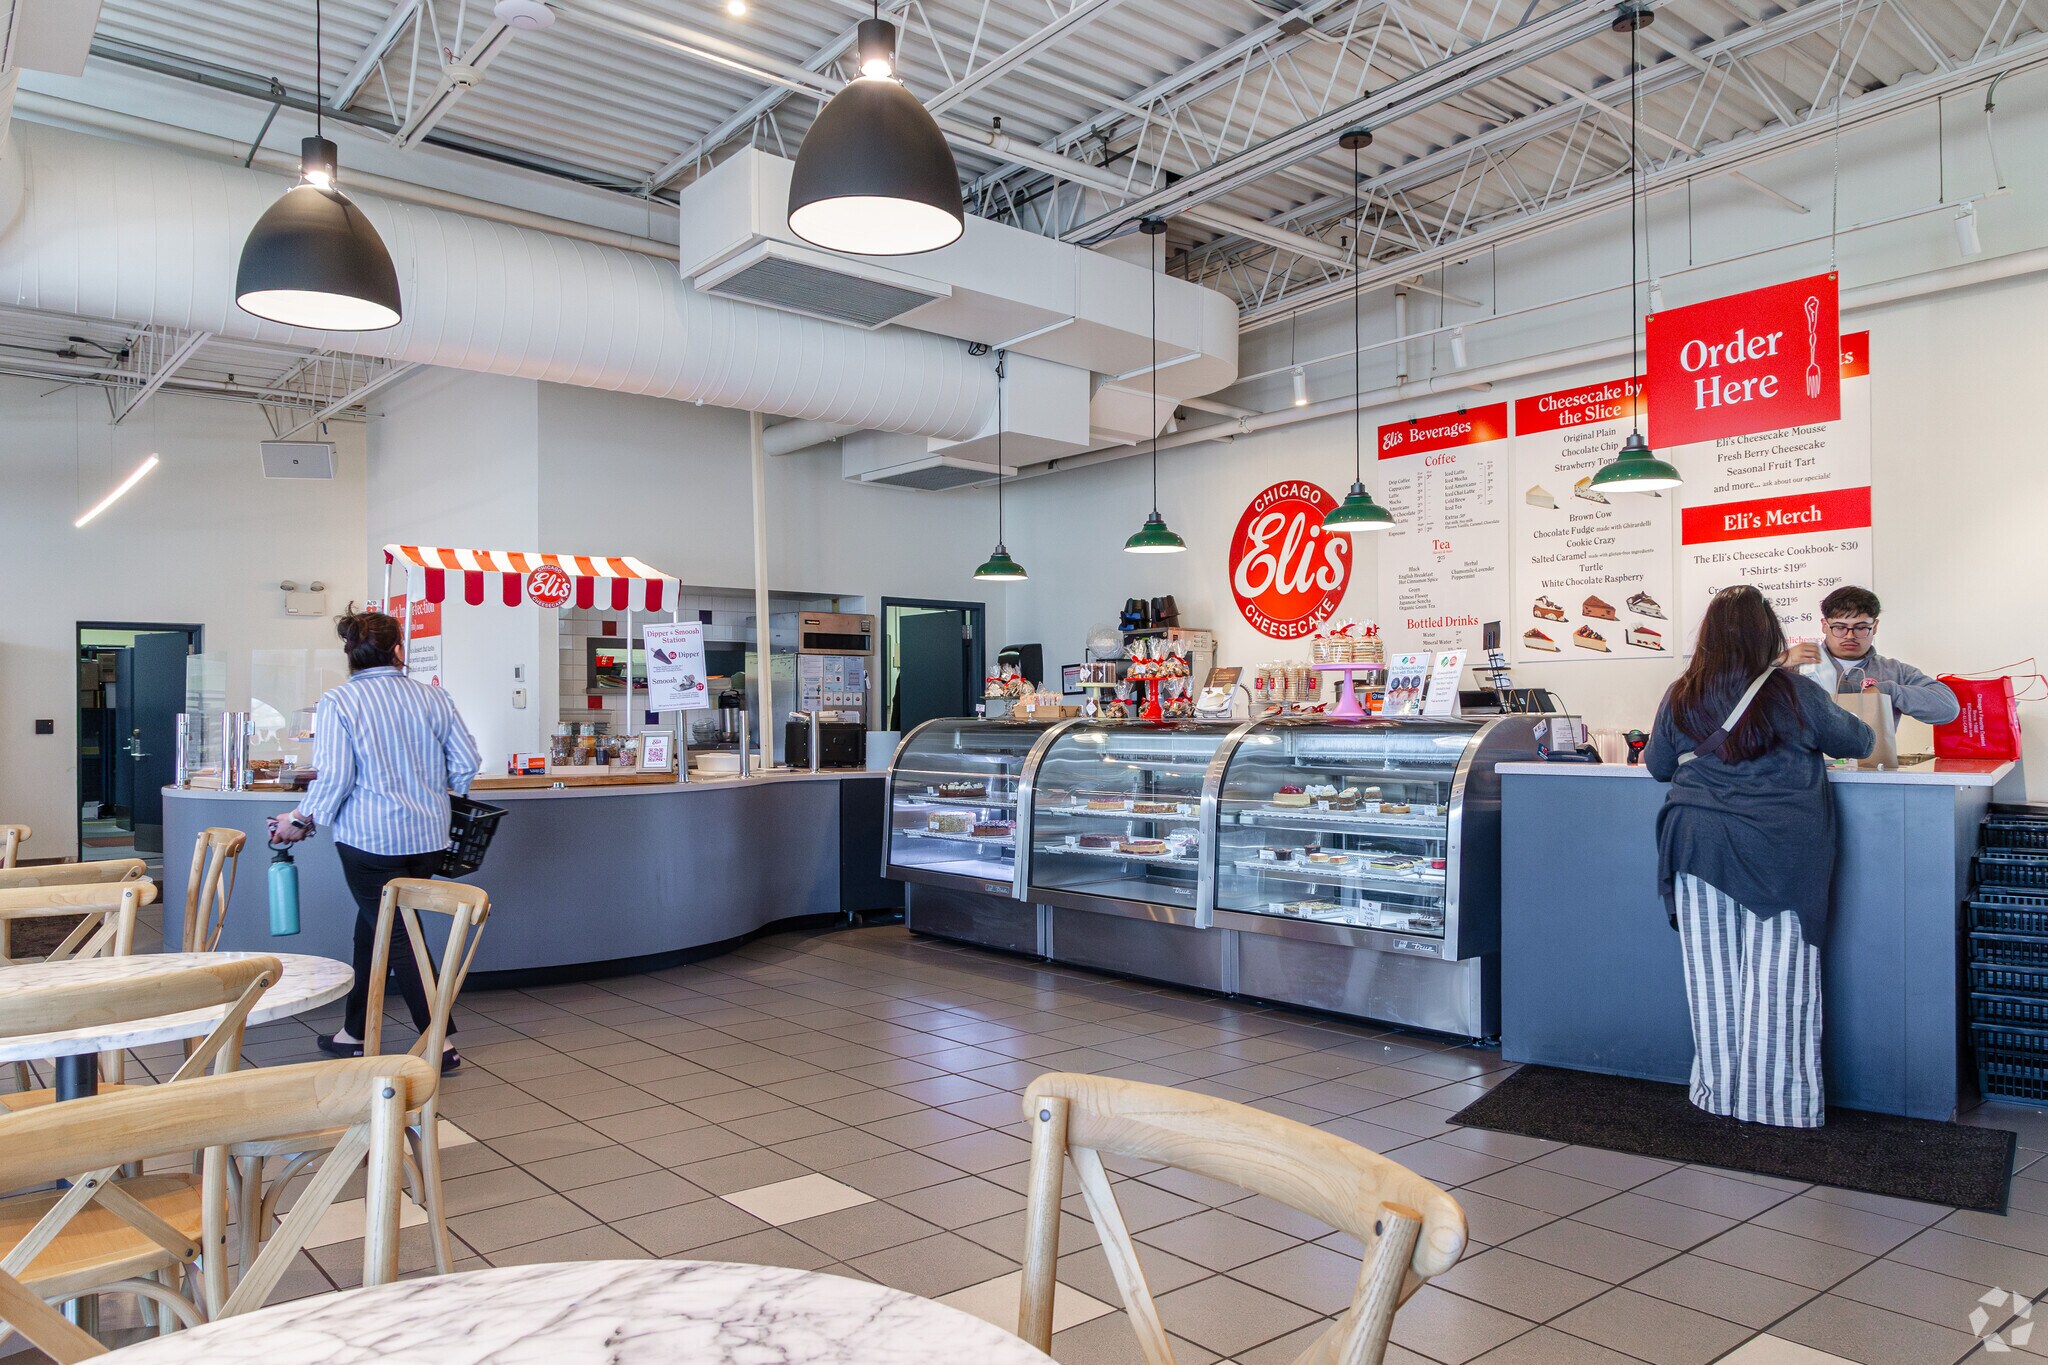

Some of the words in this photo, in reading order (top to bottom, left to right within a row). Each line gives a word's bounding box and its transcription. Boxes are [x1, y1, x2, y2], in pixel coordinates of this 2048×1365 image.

[1680, 328, 1783, 372] Order
[1538, 385, 1622, 412] Cheesecake
[1624, 381, 1642, 398] by
[1694, 374, 1778, 410] Here
[1558, 410, 1582, 426] the
[1585, 404, 1622, 422] Slice
[1409, 422, 1472, 442] Beverages
[1563, 430, 1595, 444] Original
[1596, 428, 1616, 438] Plain
[1716, 437, 1735, 448] Eli's
[1738, 430, 1789, 444] Cheesecake
[1792, 426, 1826, 436] Mousse
[1562, 445, 1599, 458] Chocolate
[1600, 442, 1619, 452] Chip
[1718, 451, 1742, 462] Fresh
[1744, 449, 1770, 458] Berry
[1772, 440, 1826, 454] Cheesecake
[1424, 454, 1456, 466] Coffee
[1554, 460, 1596, 472] Strawberry
[1726, 462, 1766, 476] Seasonal
[1768, 460, 1792, 471] Fruit
[1794, 457, 1816, 467] Tart
[1714, 483, 1730, 493] and
[1774, 478, 1792, 486] about
[1254, 484, 1321, 512] CHICAGO
[1570, 514, 1594, 522] Brown
[1724, 512, 1762, 531] Eli's
[1766, 504, 1822, 527] Merch
[1534, 528, 1570, 538] Chocolate
[1571, 526, 1595, 536] Fudge
[1623, 520, 1651, 529] Ghirardelli
[1432, 539, 1450, 550] Tea
[1566, 538, 1592, 548] Cookie
[1594, 536, 1615, 545] Crazy
[1532, 554, 1555, 564] Salted
[1556, 551, 1587, 562] Caramel
[1694, 556, 1710, 564] The
[1712, 553, 1731, 563] Eli's
[1733, 548, 1785, 561] Cheesecake
[1841, 541, 1858, 550] $30
[538, 565, 562, 573] CHICAGO
[1579, 563, 1603, 572] Turtle
[1541, 578, 1564, 588] White
[1566, 576, 1602, 586] Chocolate
[1604, 573, 1644, 584] Raspberry
[1245, 598, 1334, 637] CHEESECAKE
[1407, 616, 1443, 629] Bottled
[1445, 614, 1478, 627] Drinks
[1800, 613, 1812, 621] $6
[652, 677, 678, 685] Smoosh
